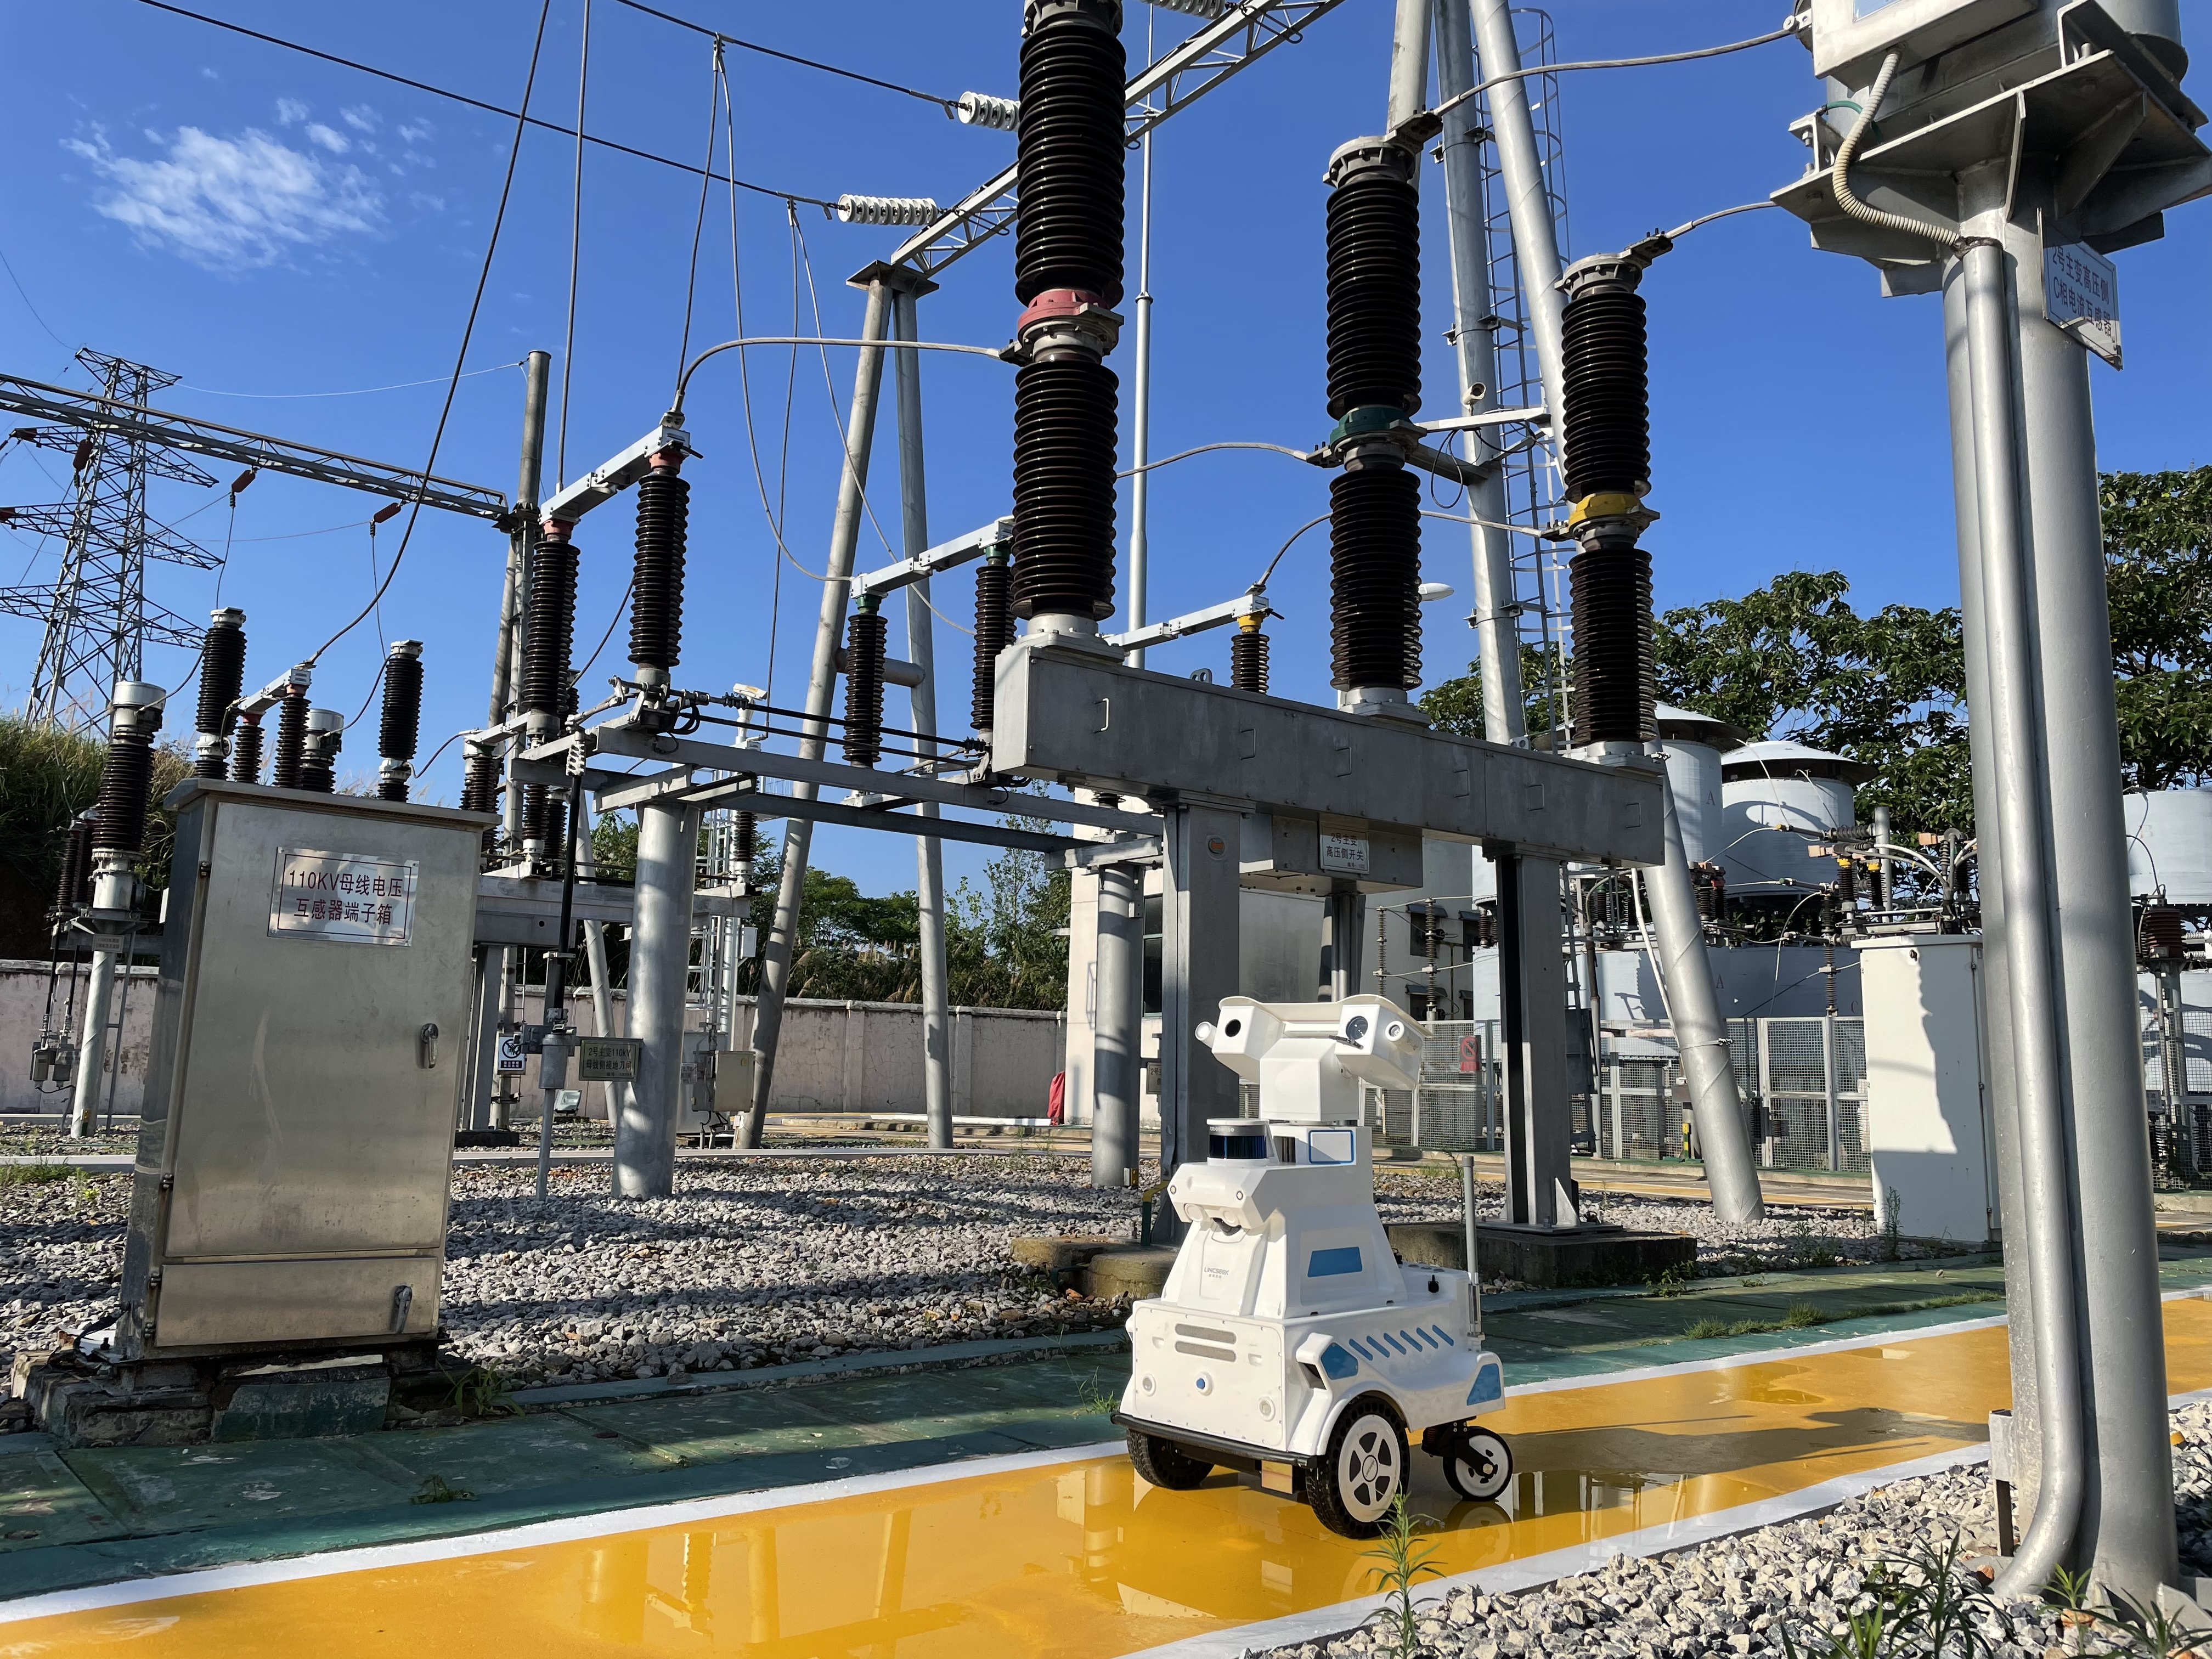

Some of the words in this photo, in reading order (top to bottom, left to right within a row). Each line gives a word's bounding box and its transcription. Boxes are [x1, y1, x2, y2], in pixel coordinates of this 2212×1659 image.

[2052, 244, 2110, 305] 2号主变高压侧
[2054, 276, 2112, 338] C相电流互感器
[1706, 790, 1716, 806] A
[1331, 832, 1357, 847] 2号主变
[1326, 845, 1364, 861] 高压侧开关
[289, 870, 403, 898] 110KV母线电压
[294, 898, 393, 925] 互感器端子箱
[1716, 974, 1725, 989] A
